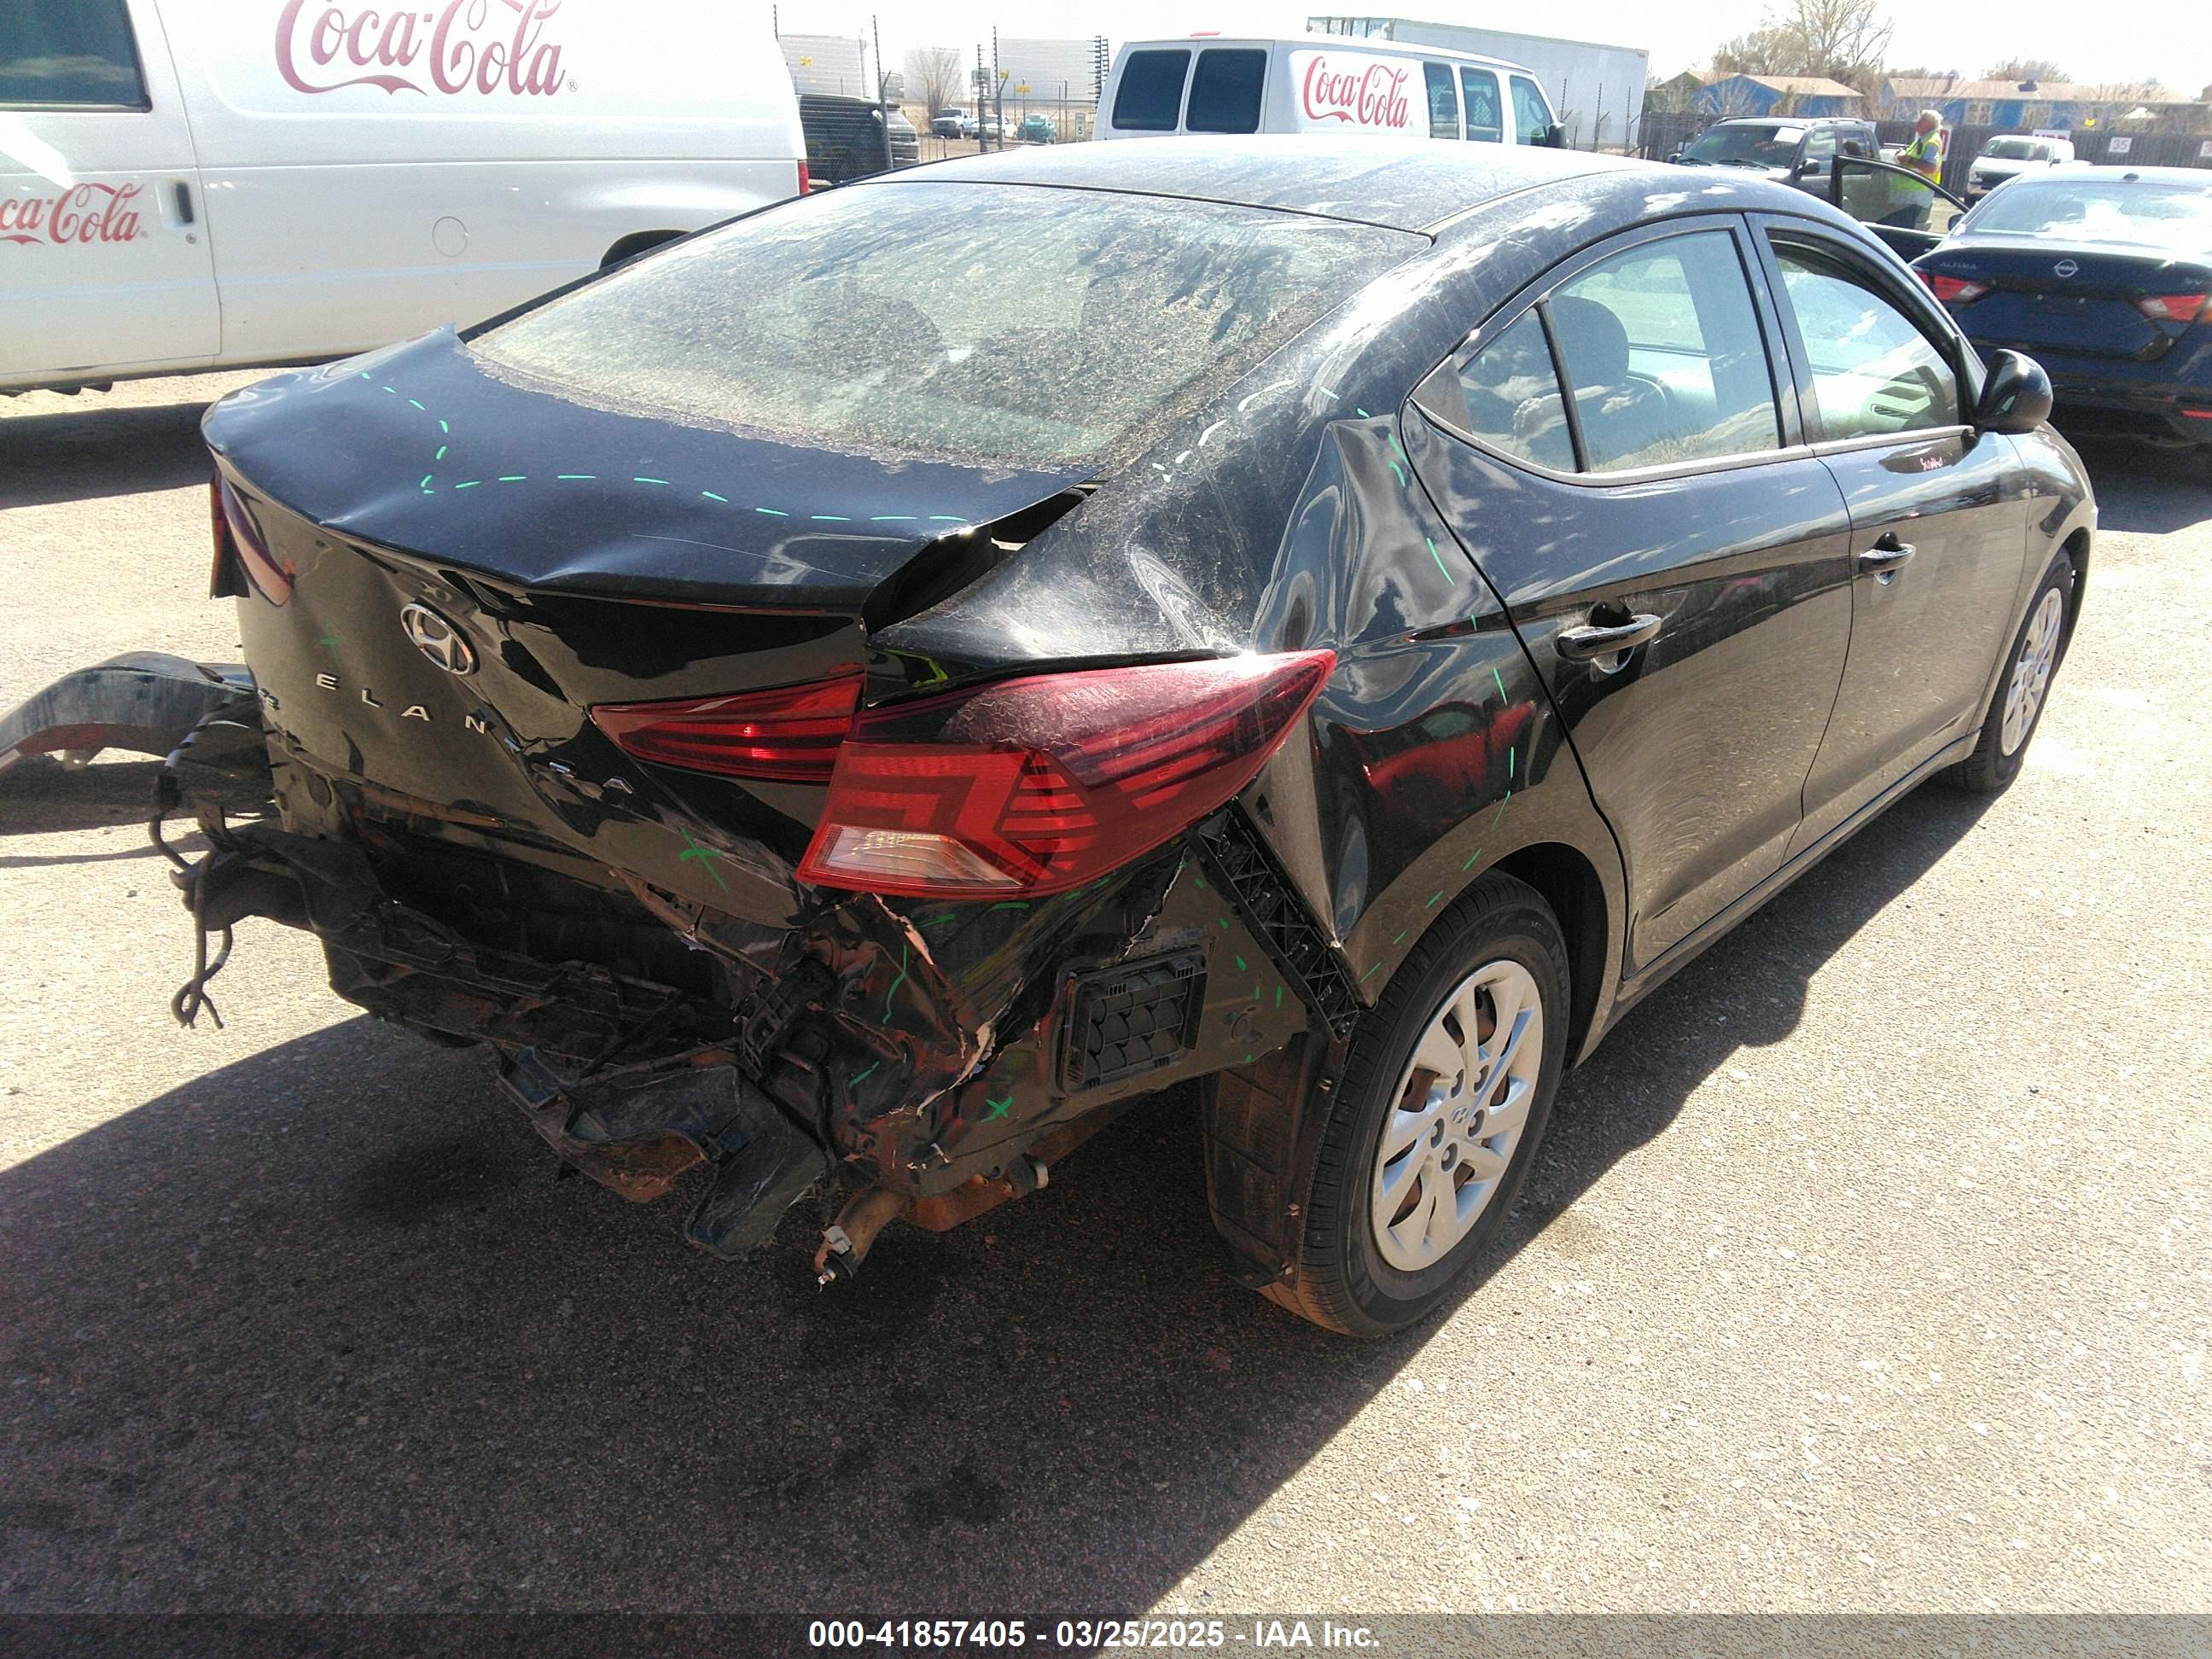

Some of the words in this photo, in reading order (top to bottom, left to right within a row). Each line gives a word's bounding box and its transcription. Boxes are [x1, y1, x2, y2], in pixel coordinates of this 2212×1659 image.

[275, 0, 566, 96] Coca-Cola
[1303, 56, 1409, 128] Coca-Cola
[2113, 140, 2129, 151] 35
[316, 672, 633, 795] ELANA
